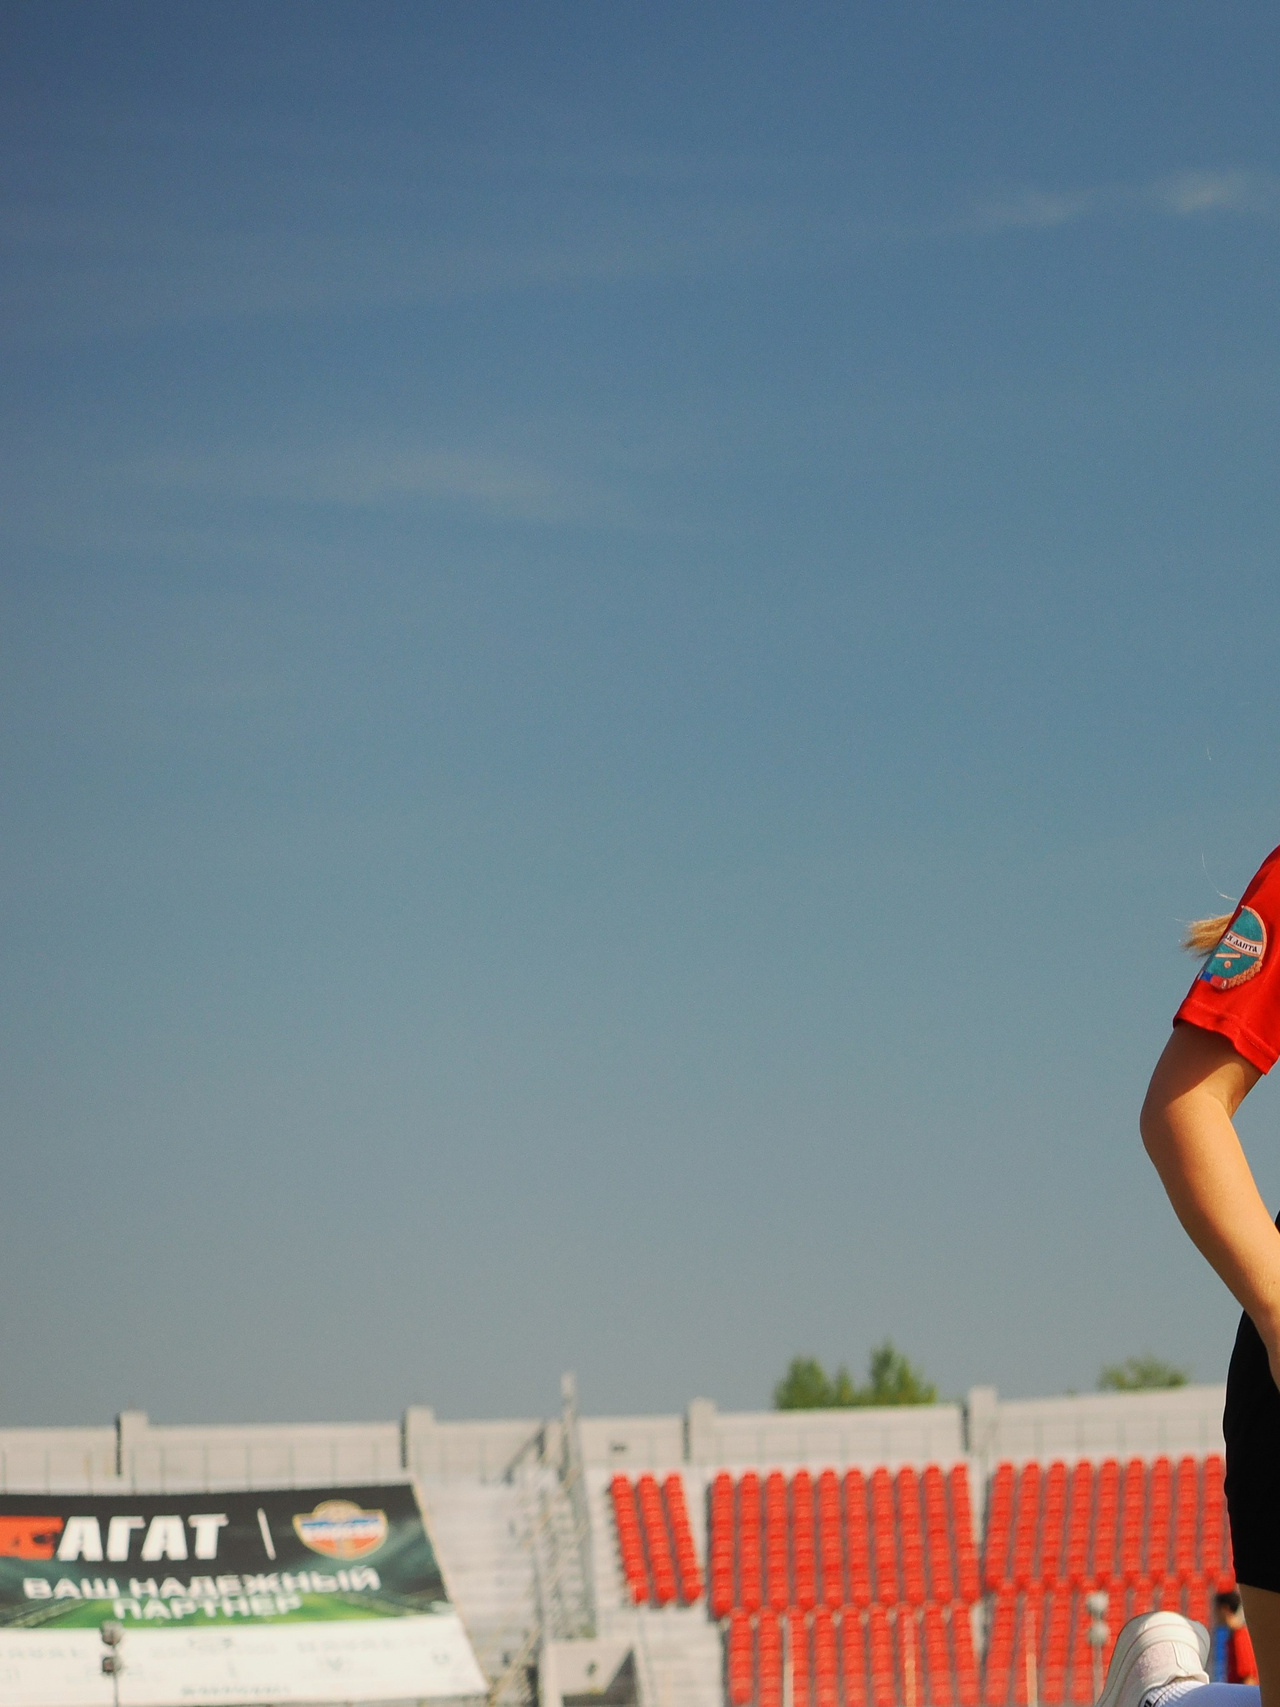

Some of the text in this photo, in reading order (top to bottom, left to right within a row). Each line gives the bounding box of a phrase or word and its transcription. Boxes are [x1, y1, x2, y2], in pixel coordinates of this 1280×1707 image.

[56, 1514, 230, 1561] АГАТ
[24, 1566, 381, 1600] ВАШ НАДЕЖНЫЙ
[112, 1593, 302, 1619] ПАРТНЕР
